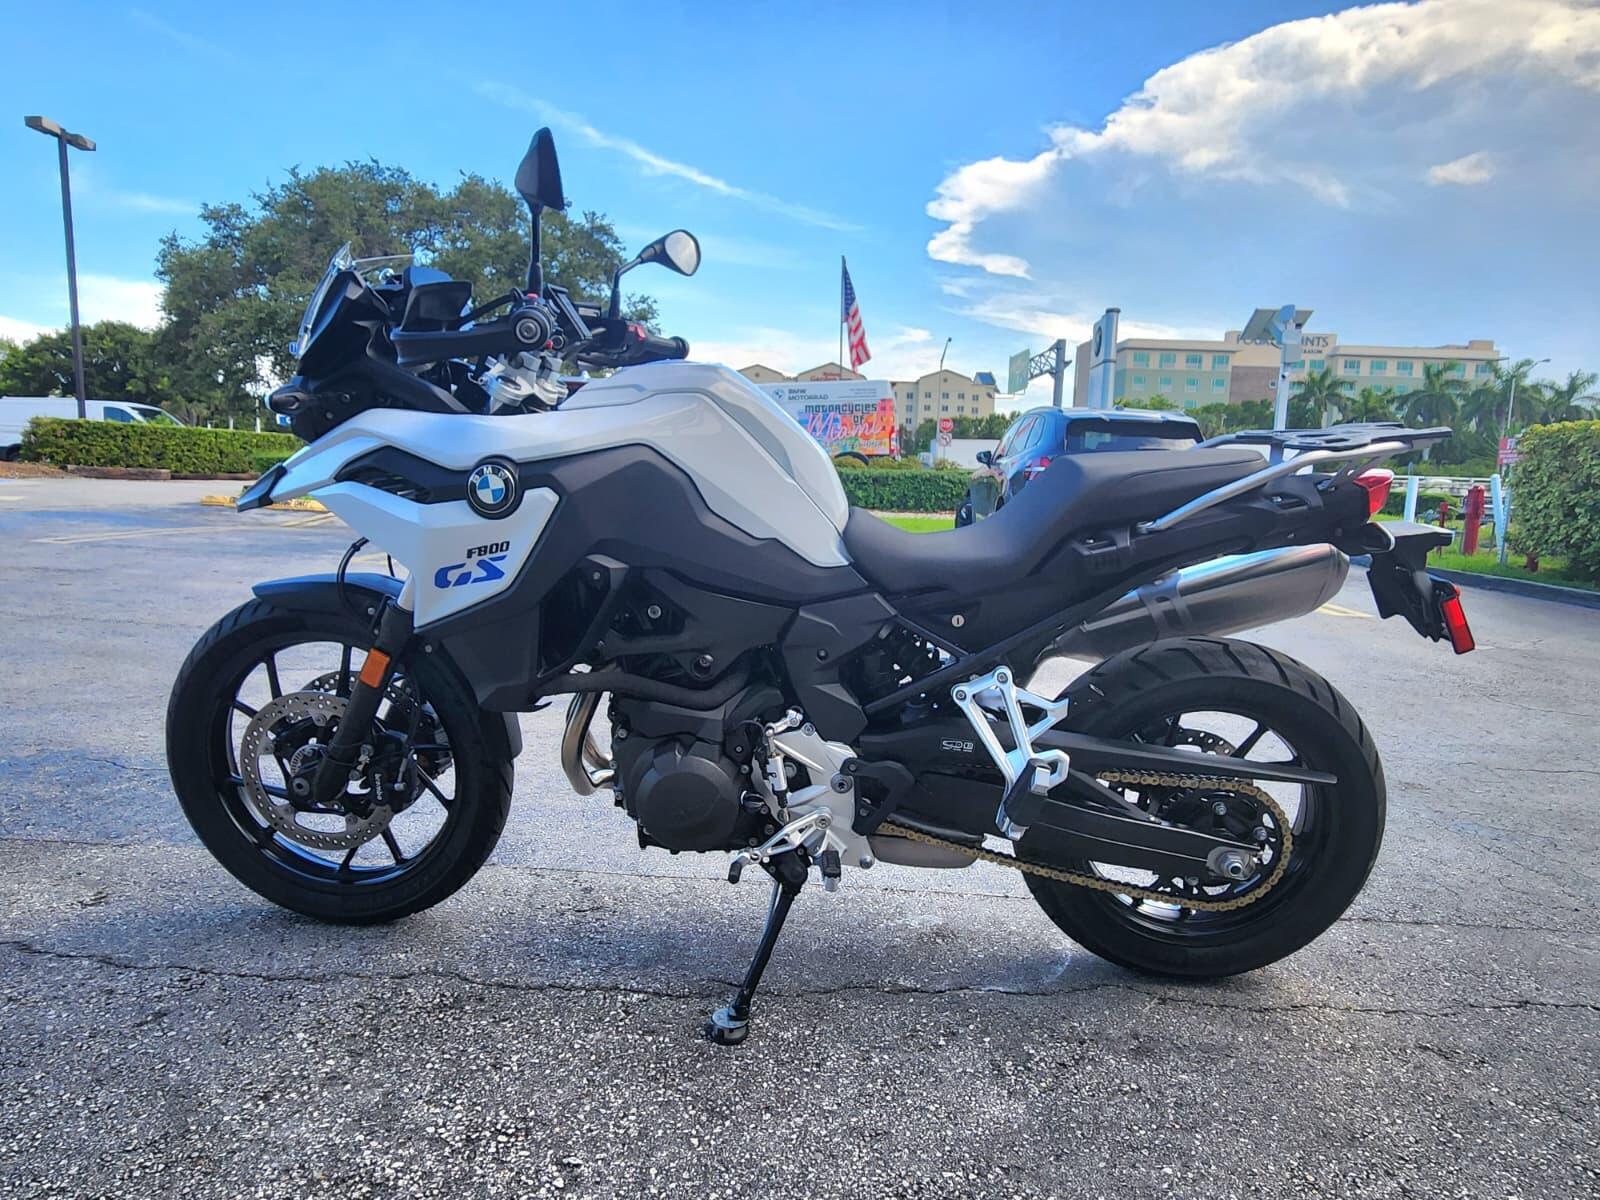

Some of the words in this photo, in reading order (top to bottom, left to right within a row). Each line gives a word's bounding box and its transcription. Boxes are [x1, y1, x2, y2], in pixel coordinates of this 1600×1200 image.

[807, 412, 883, 443] Miami
[472, 465, 508, 483] BMW
[466, 541, 511, 559] F800
[434, 555, 508, 589] GS
